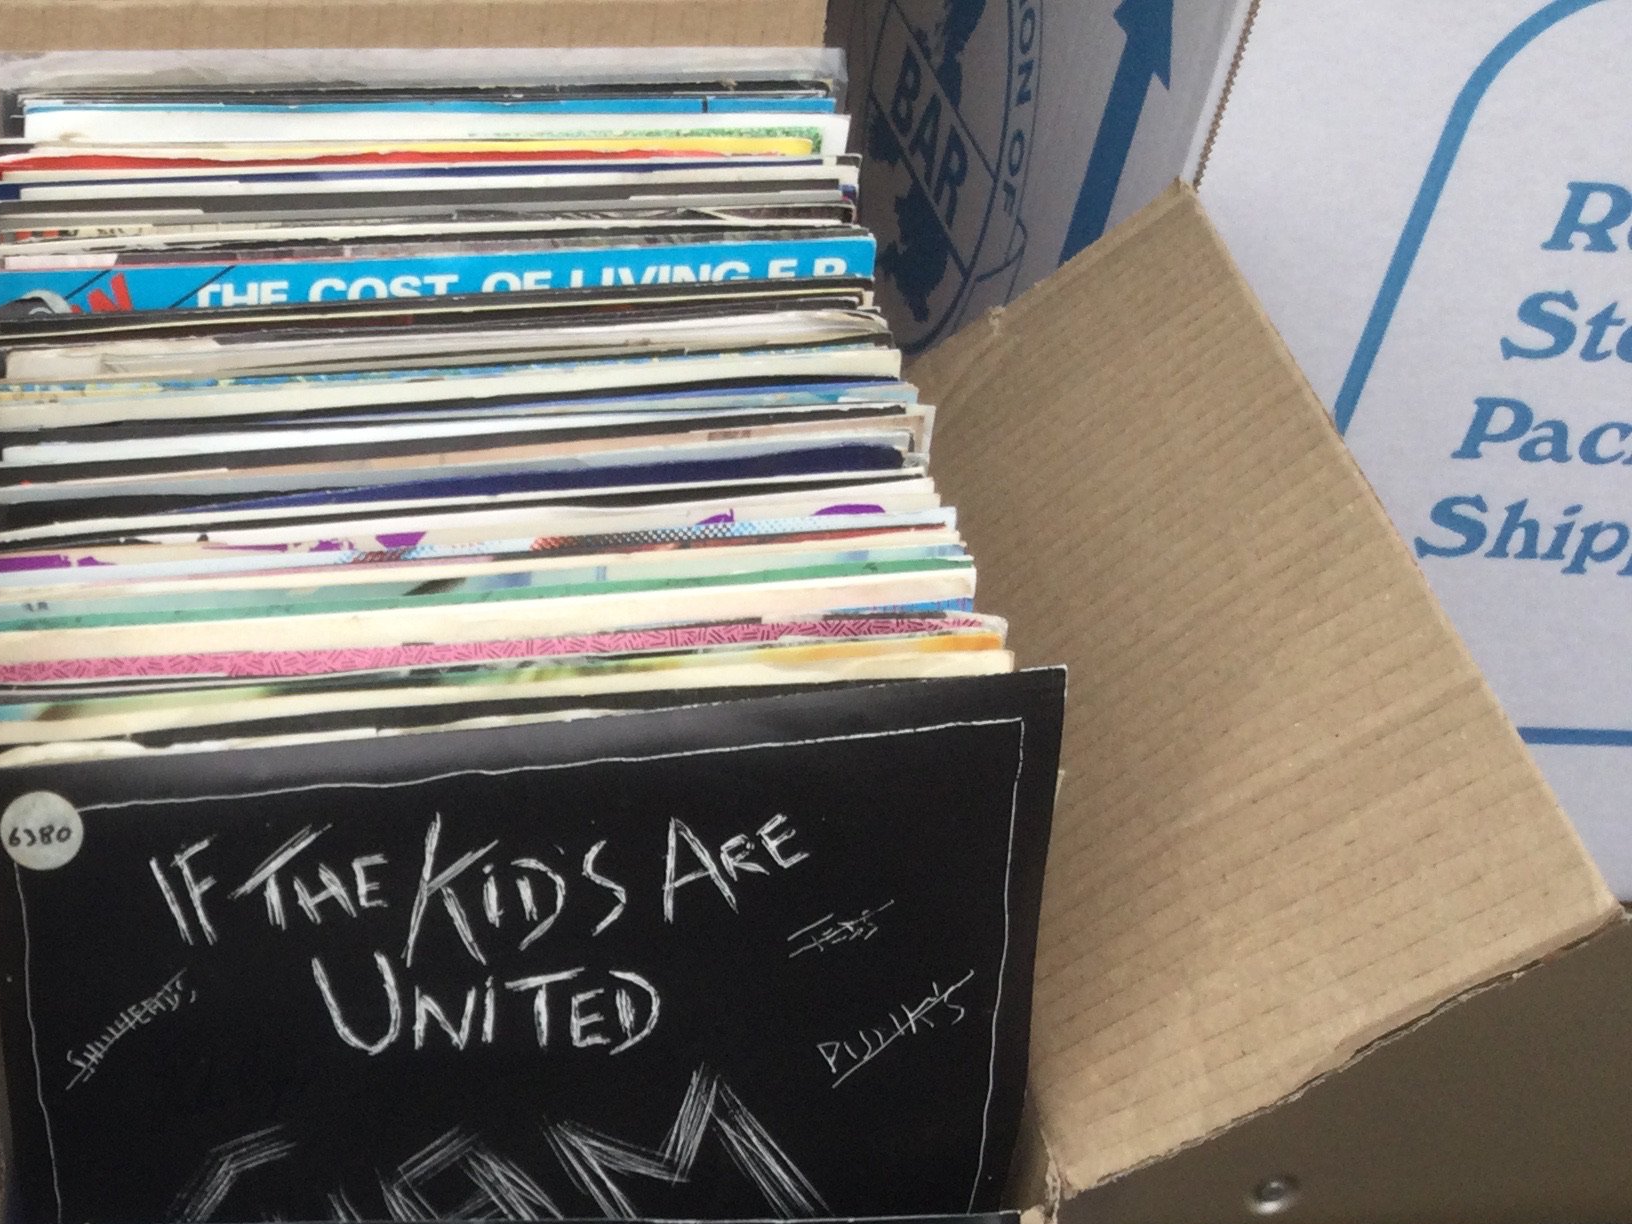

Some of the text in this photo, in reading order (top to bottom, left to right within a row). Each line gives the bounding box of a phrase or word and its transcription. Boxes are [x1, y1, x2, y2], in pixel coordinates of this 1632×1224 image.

[891, 46, 968, 230] BAR
[307, 273, 460, 302] COST
[1451, 396, 1632, 466] Pac
[148, 834, 220, 946] IF
[227, 822, 390, 931] THE
[661, 813, 811, 924] ARE
